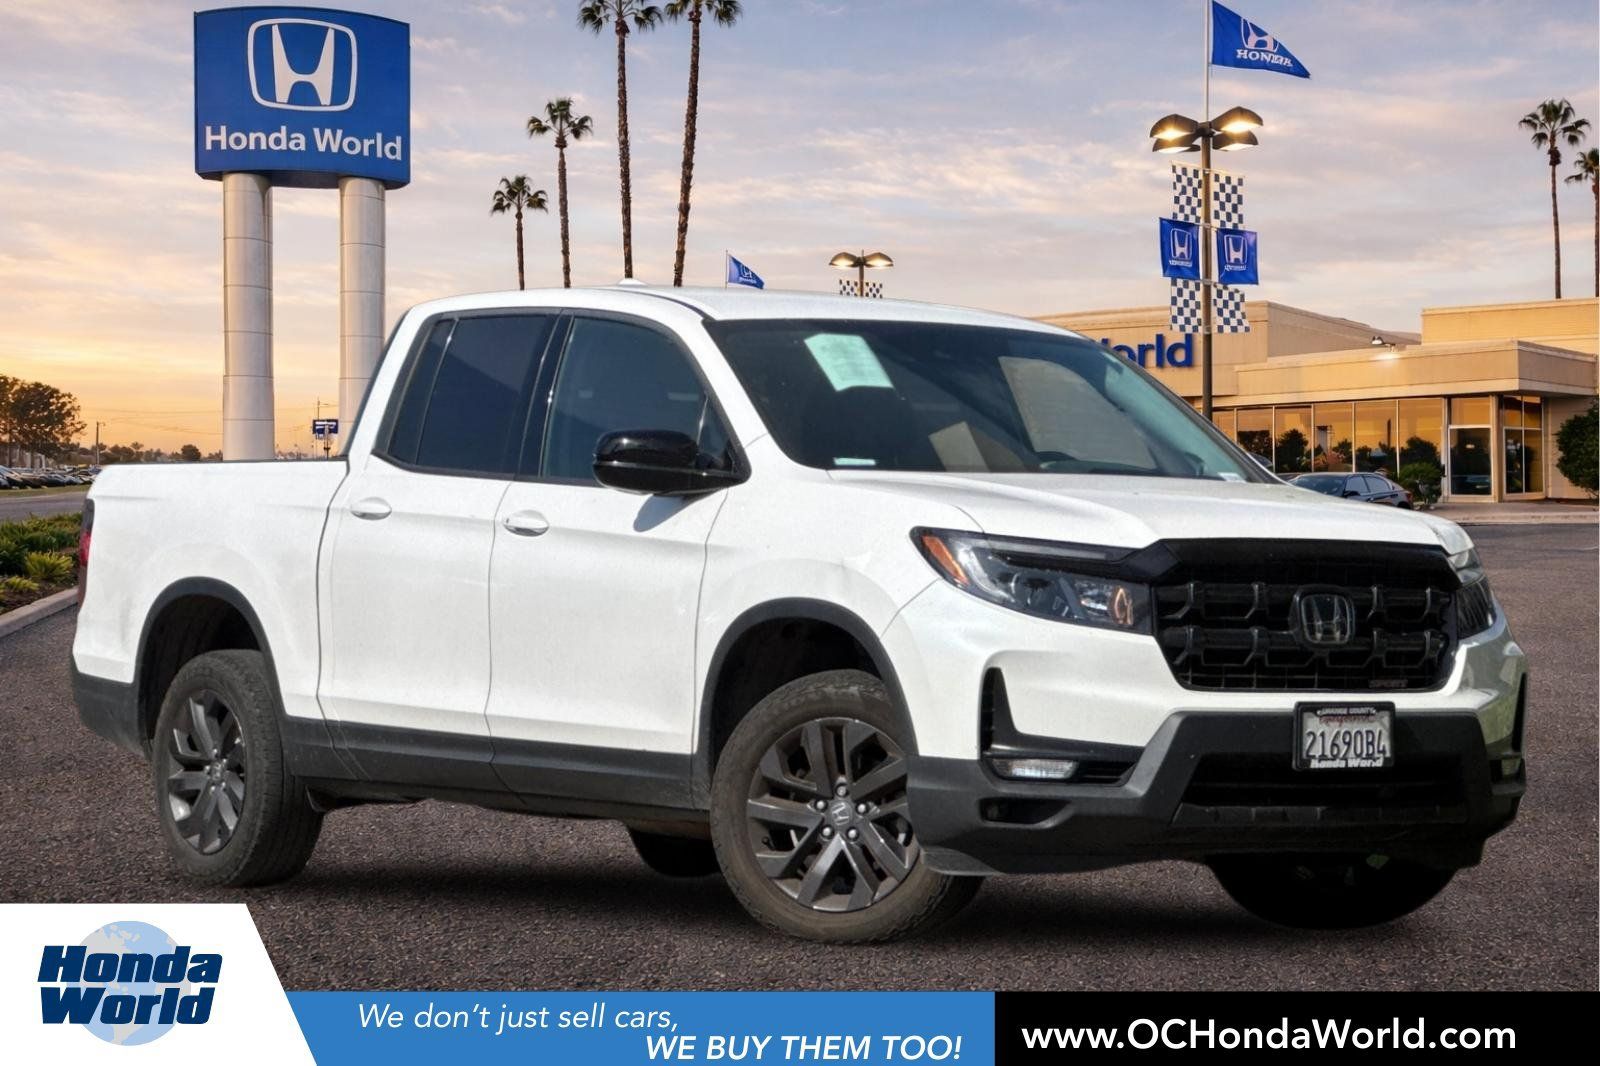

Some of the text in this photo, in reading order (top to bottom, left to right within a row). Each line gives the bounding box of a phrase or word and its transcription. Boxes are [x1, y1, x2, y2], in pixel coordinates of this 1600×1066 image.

[205, 126, 403, 161] Honda World
[1101, 333, 1194, 368] orld
[1305, 730, 1387, 759] 21690B4
